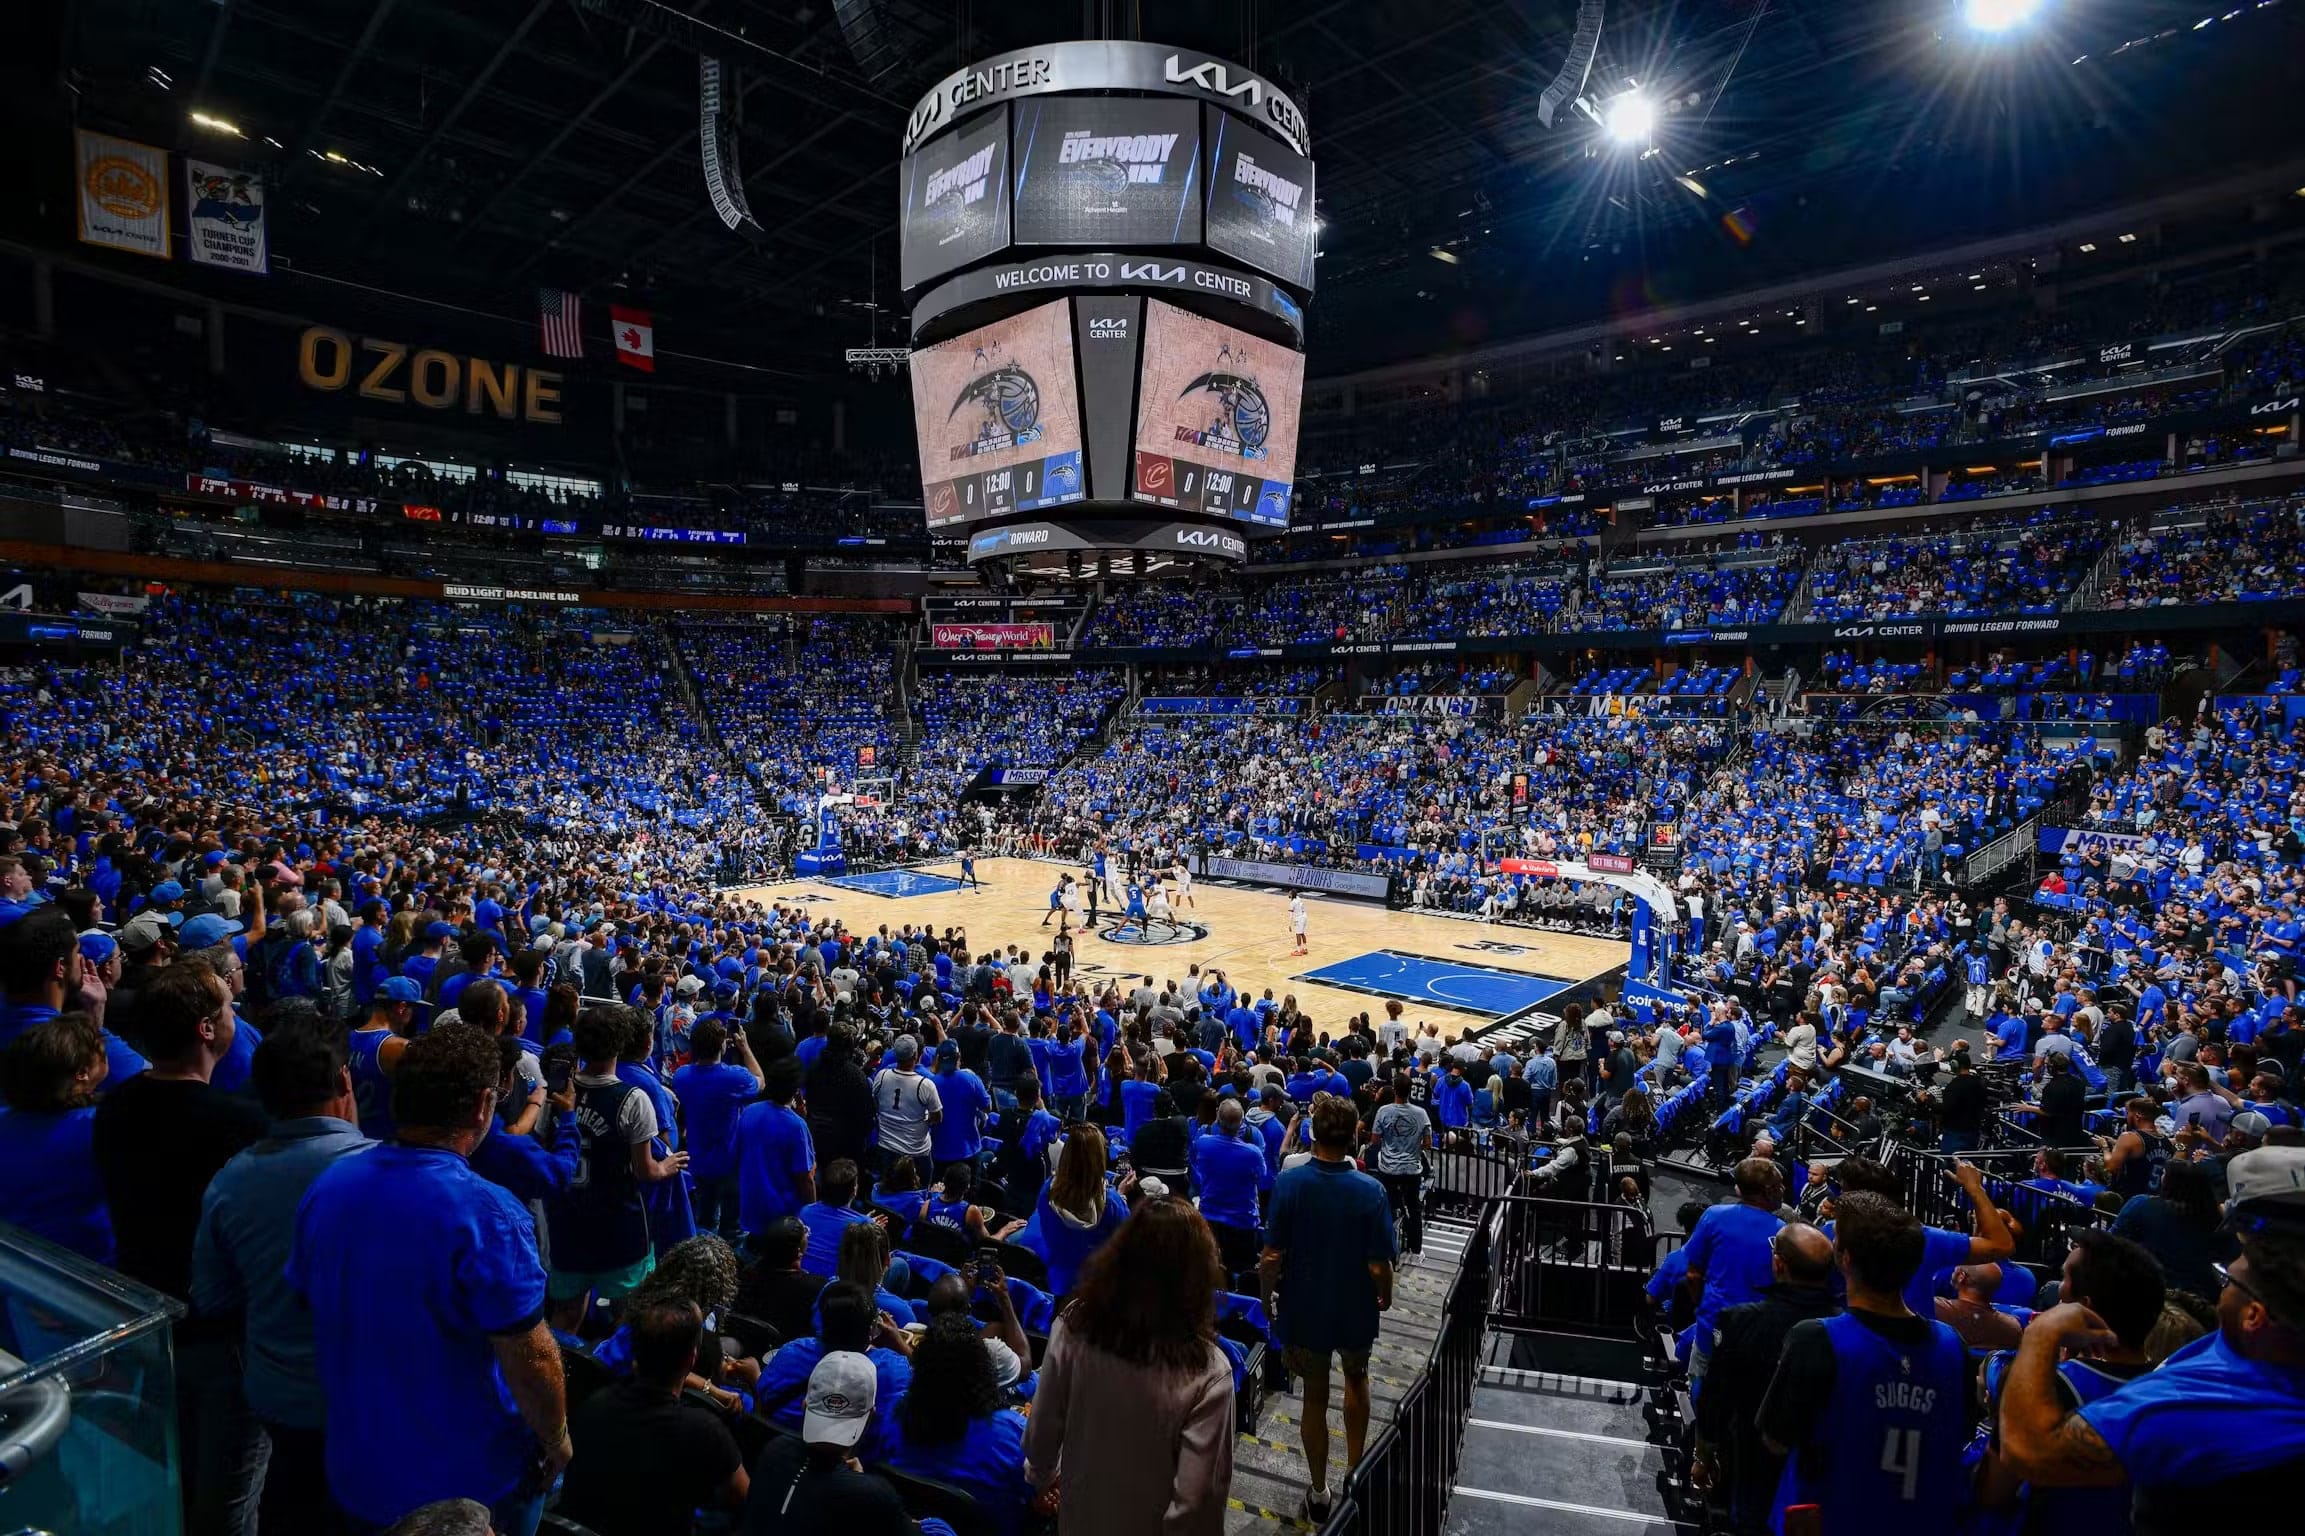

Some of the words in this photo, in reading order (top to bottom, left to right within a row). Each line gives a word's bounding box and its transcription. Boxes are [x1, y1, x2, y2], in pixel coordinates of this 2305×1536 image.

[952, 57, 1050, 106] CENTER
[1059, 134, 1178, 163] EVERYBODY
[203, 228, 237, 244] TURNER
[238, 233, 256, 247] CUP
[203, 240, 255, 257] CHAMPIONS
[996, 265, 1079, 288] WELCOME
[1084, 263, 1110, 279] TO
[1194, 270, 1251, 298] CENTER
[1090, 330, 1127, 339] CENTER
[299, 326, 563, 425] OZONE
[2106, 424, 2146, 437] FORWARD
[67, 459, 100, 472] FORWARD
[986, 472, 1011, 494] 12:00
[1026, 471, 1033, 493] 0
[1184, 472, 1194, 493] 0
[1206, 472, 1233, 494] 12:00
[1673, 480, 1704, 490] CENTER
[967, 484, 973, 505] 0
[1242, 485, 1252, 505] 0
[1010, 530, 1048, 545] ORWARD
[446, 587, 468, 596] BUD
[471, 588, 502, 598] LIGHT
[506, 590, 556, 600] BASELINE
[557, 593, 580, 601] BAR
[81, 630, 112, 641] FORWARD
[1002, 630, 1029, 641] World
[1714, 631, 1748, 641] FORWARD
[1879, 625, 1923, 636] CENTER
[1944, 623, 1979, 634] DRIVING
[1981, 621, 2014, 632] LEGEND
[2015, 619, 2060, 631] FORWARD
[1356, 645, 1381, 653] CENTER
[1009, 771, 1042, 781] MASSEY
[1209, 858, 1242, 877] PLAYOFFS
[1295, 869, 1334, 889] PLAYOFFS
[893, 1088, 901, 1110] 1
[1411, 1085, 1426, 1101] 22
[1613, 1164, 1640, 1173] SECURITY
[1875, 1384, 1936, 1416] SUGGS
[1881, 1427, 1920, 1502] 4
